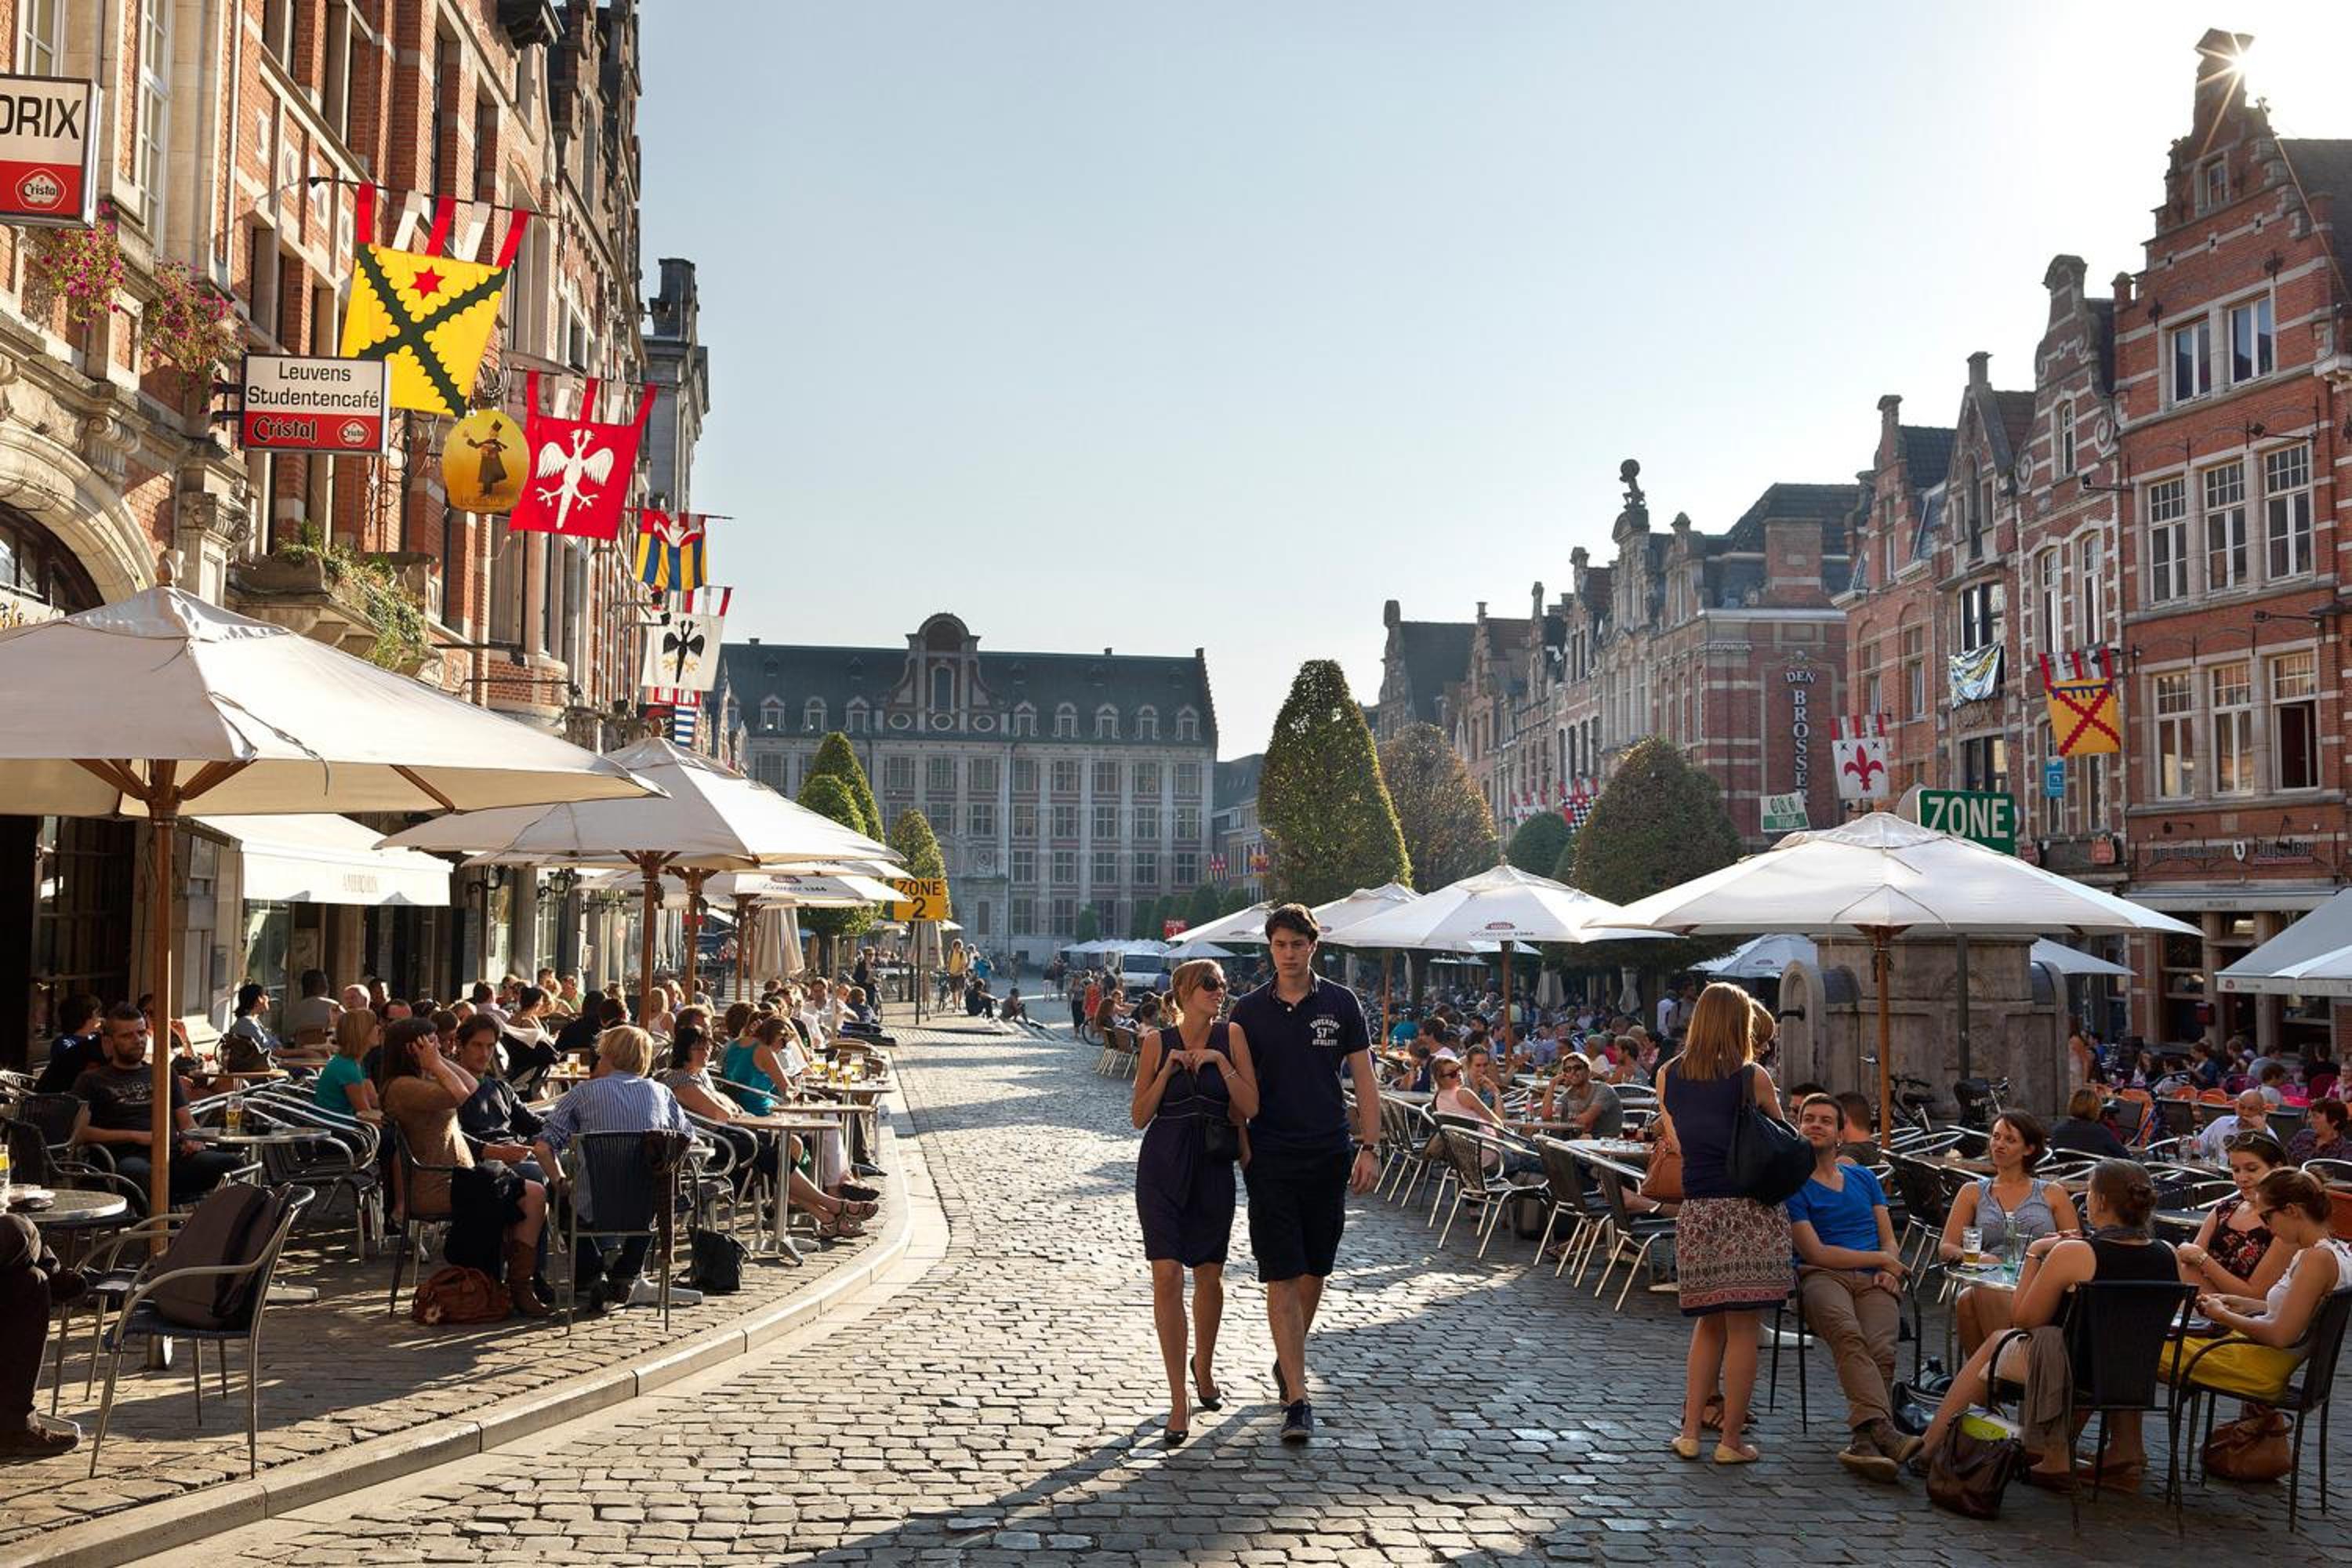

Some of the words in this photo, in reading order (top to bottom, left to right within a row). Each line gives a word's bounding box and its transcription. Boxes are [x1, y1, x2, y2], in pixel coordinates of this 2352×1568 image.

[278, 361, 350, 382] Leuvens
[248, 385, 379, 408] Studentencafé
[252, 416, 317, 443] Cristal
[1786, 671, 1816, 684] DEN
[1929, 797, 2009, 838] ZONE
[898, 880, 942, 895] ZONE
[913, 896, 926, 918] 2
